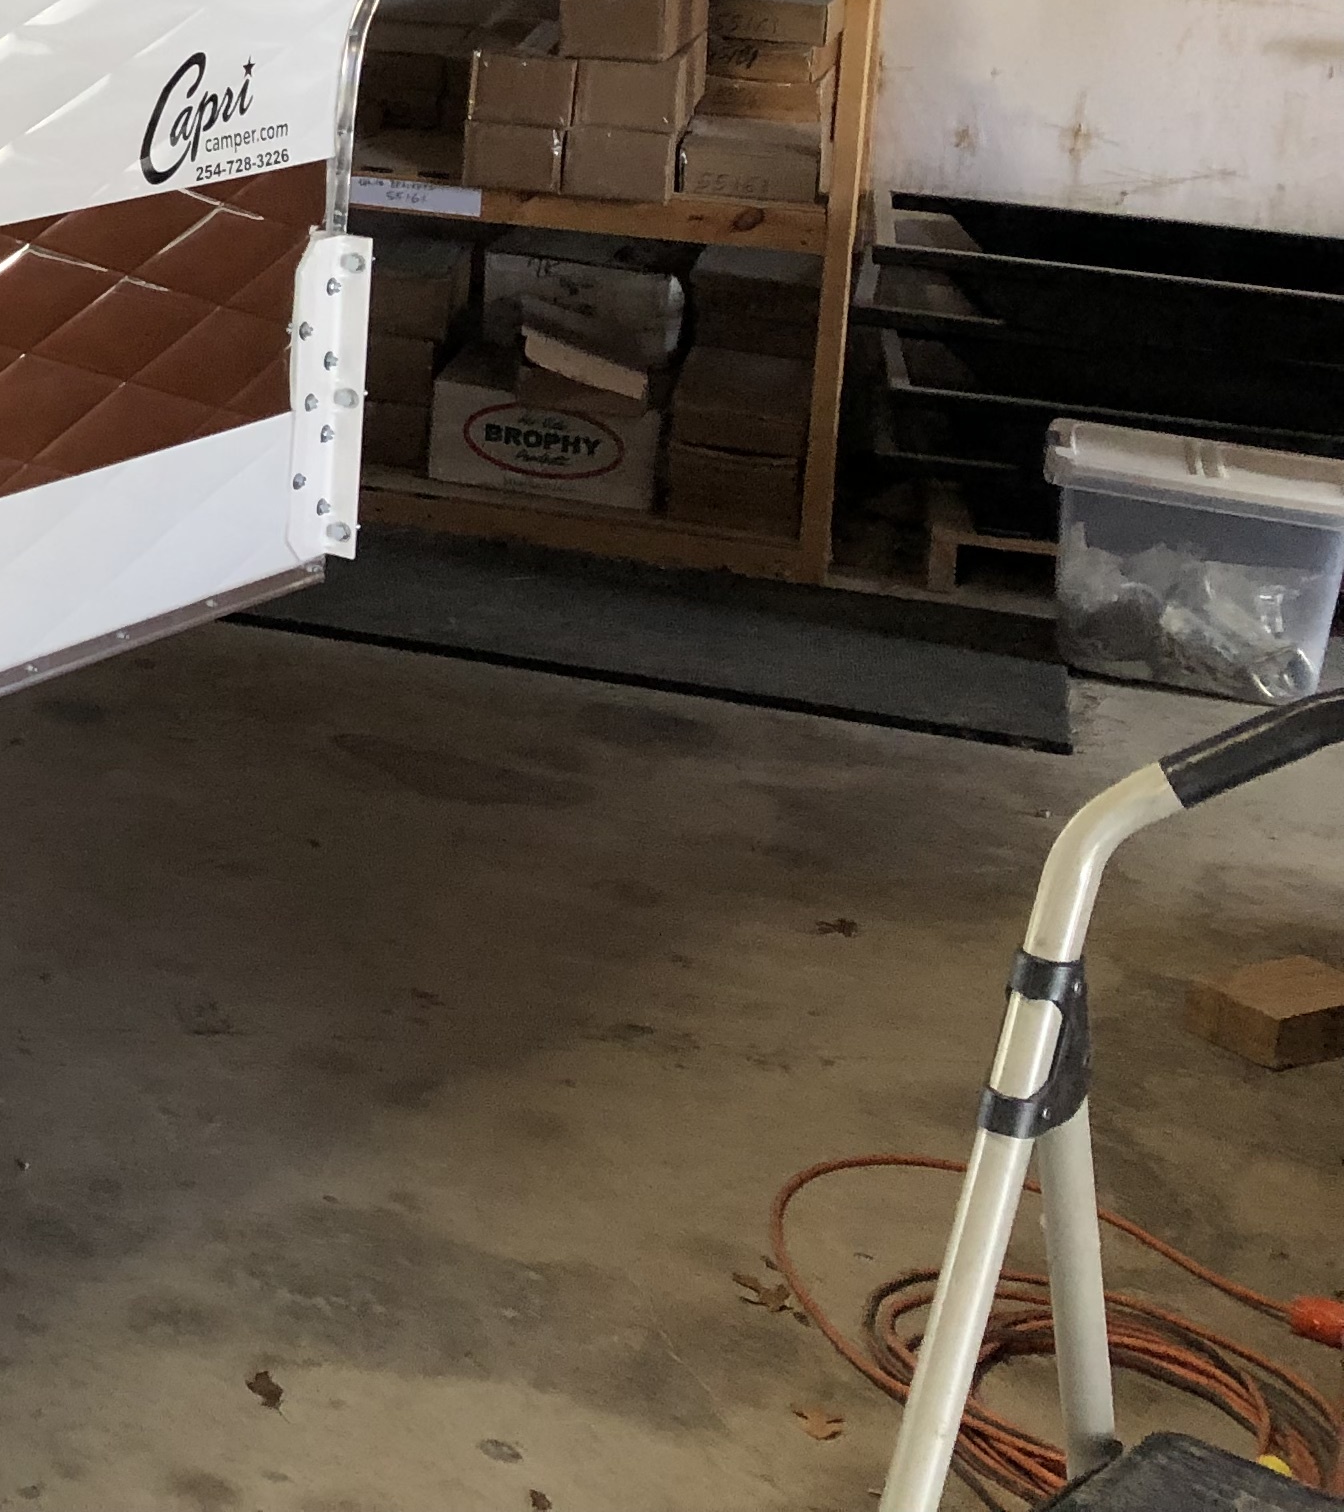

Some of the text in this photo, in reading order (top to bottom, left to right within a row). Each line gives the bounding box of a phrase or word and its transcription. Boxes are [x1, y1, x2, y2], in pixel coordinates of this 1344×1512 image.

[140, 52, 255, 185] Capri
[205, 122, 289, 154] camper.com
[195, 148, 290, 181] 254-728-3226
[484, 423, 603, 457] BROPHY
